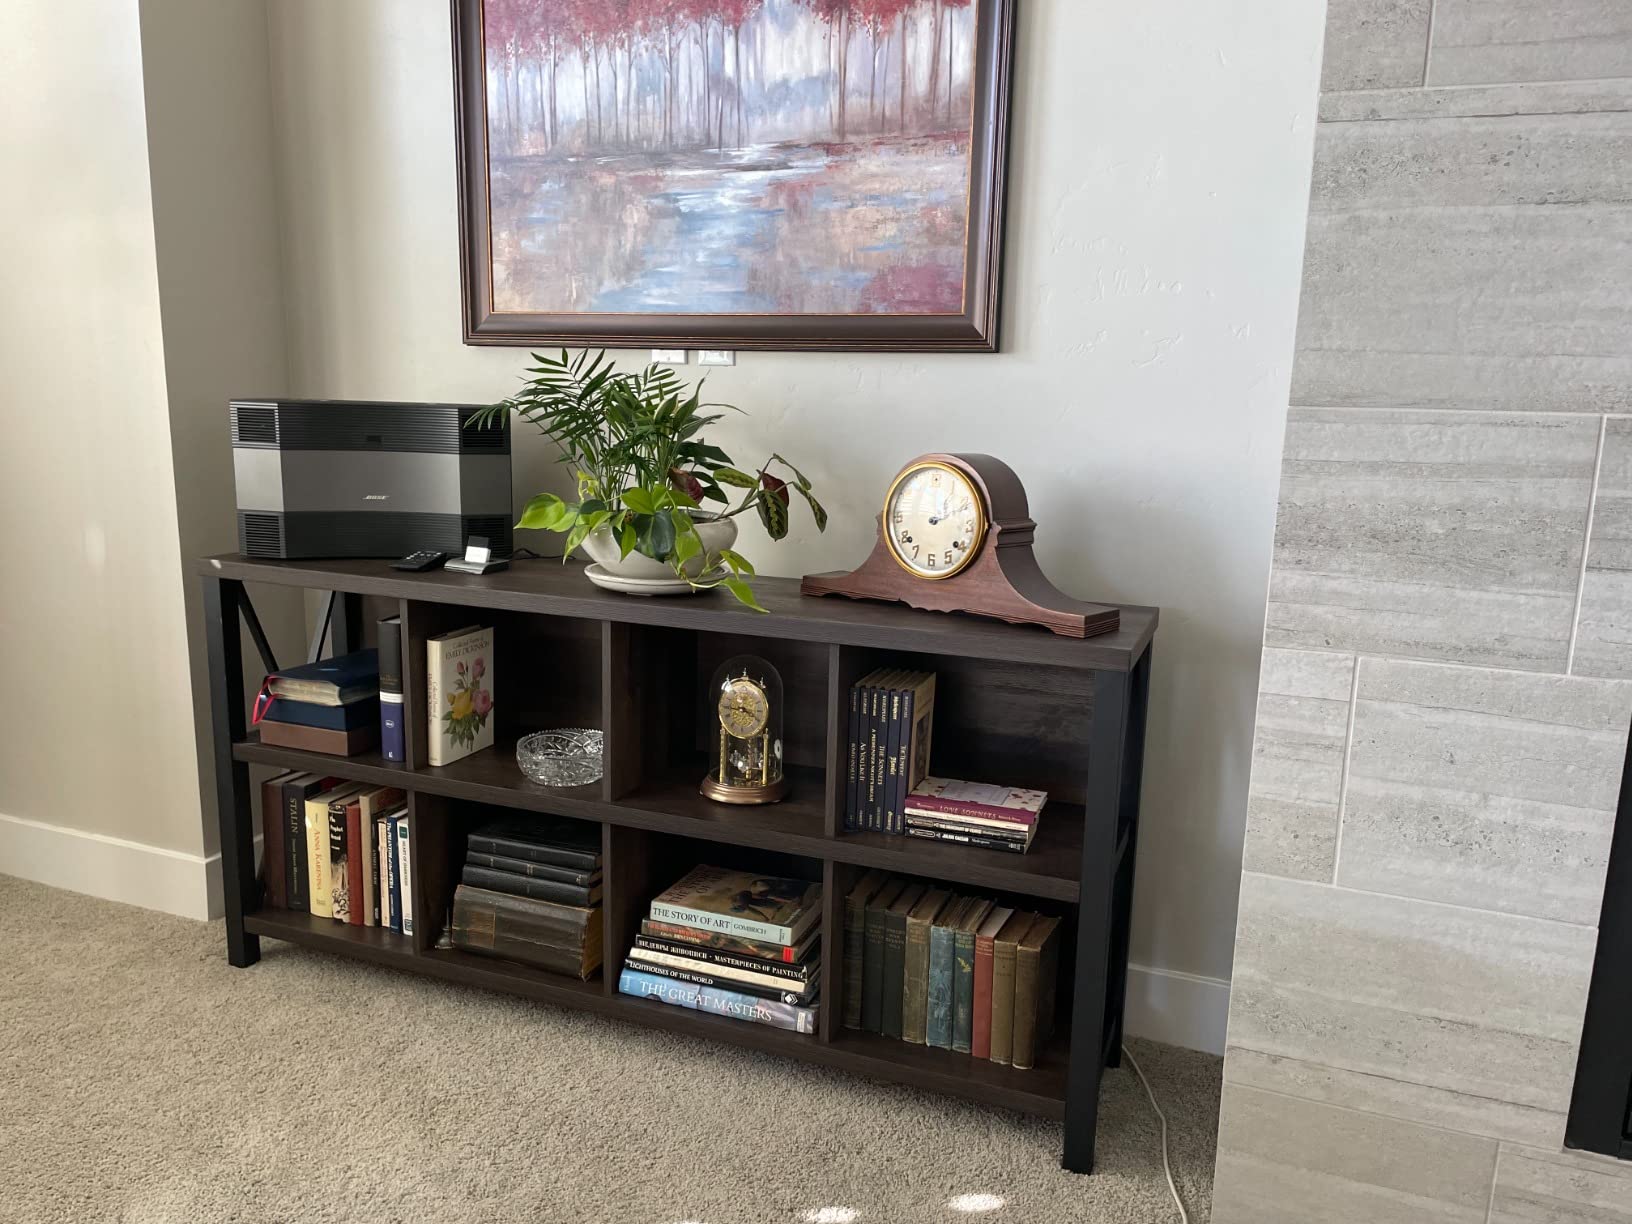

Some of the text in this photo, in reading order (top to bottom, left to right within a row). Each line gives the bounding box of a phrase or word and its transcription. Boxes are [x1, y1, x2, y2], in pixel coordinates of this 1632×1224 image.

[902, 530, 909, 544] 8
[912, 544, 920, 560] 7
[958, 540, 967, 552] 4
[928, 554, 936, 566] 6
[944, 550, 952, 564] 5
[290, 798, 298, 833] STALIN
[962, 808, 996, 818] SONNETS
[652, 907, 731, 929] THE STORY OF ART
[733, 923, 767, 936] GOMBRICH
[629, 960, 669, 976] LIGHTHOUSES
[679, 972, 691, 980] THE
[691, 974, 714, 985] WORLD
[714, 955, 762, 971] MASTERPIECES
[762, 964, 772, 973] OF
[772, 966, 803, 979] PAINTING
[640, 981, 666, 996] THE
[668, 986, 711, 1006] GREAT
[714, 996, 772, 1022] MASTERS
